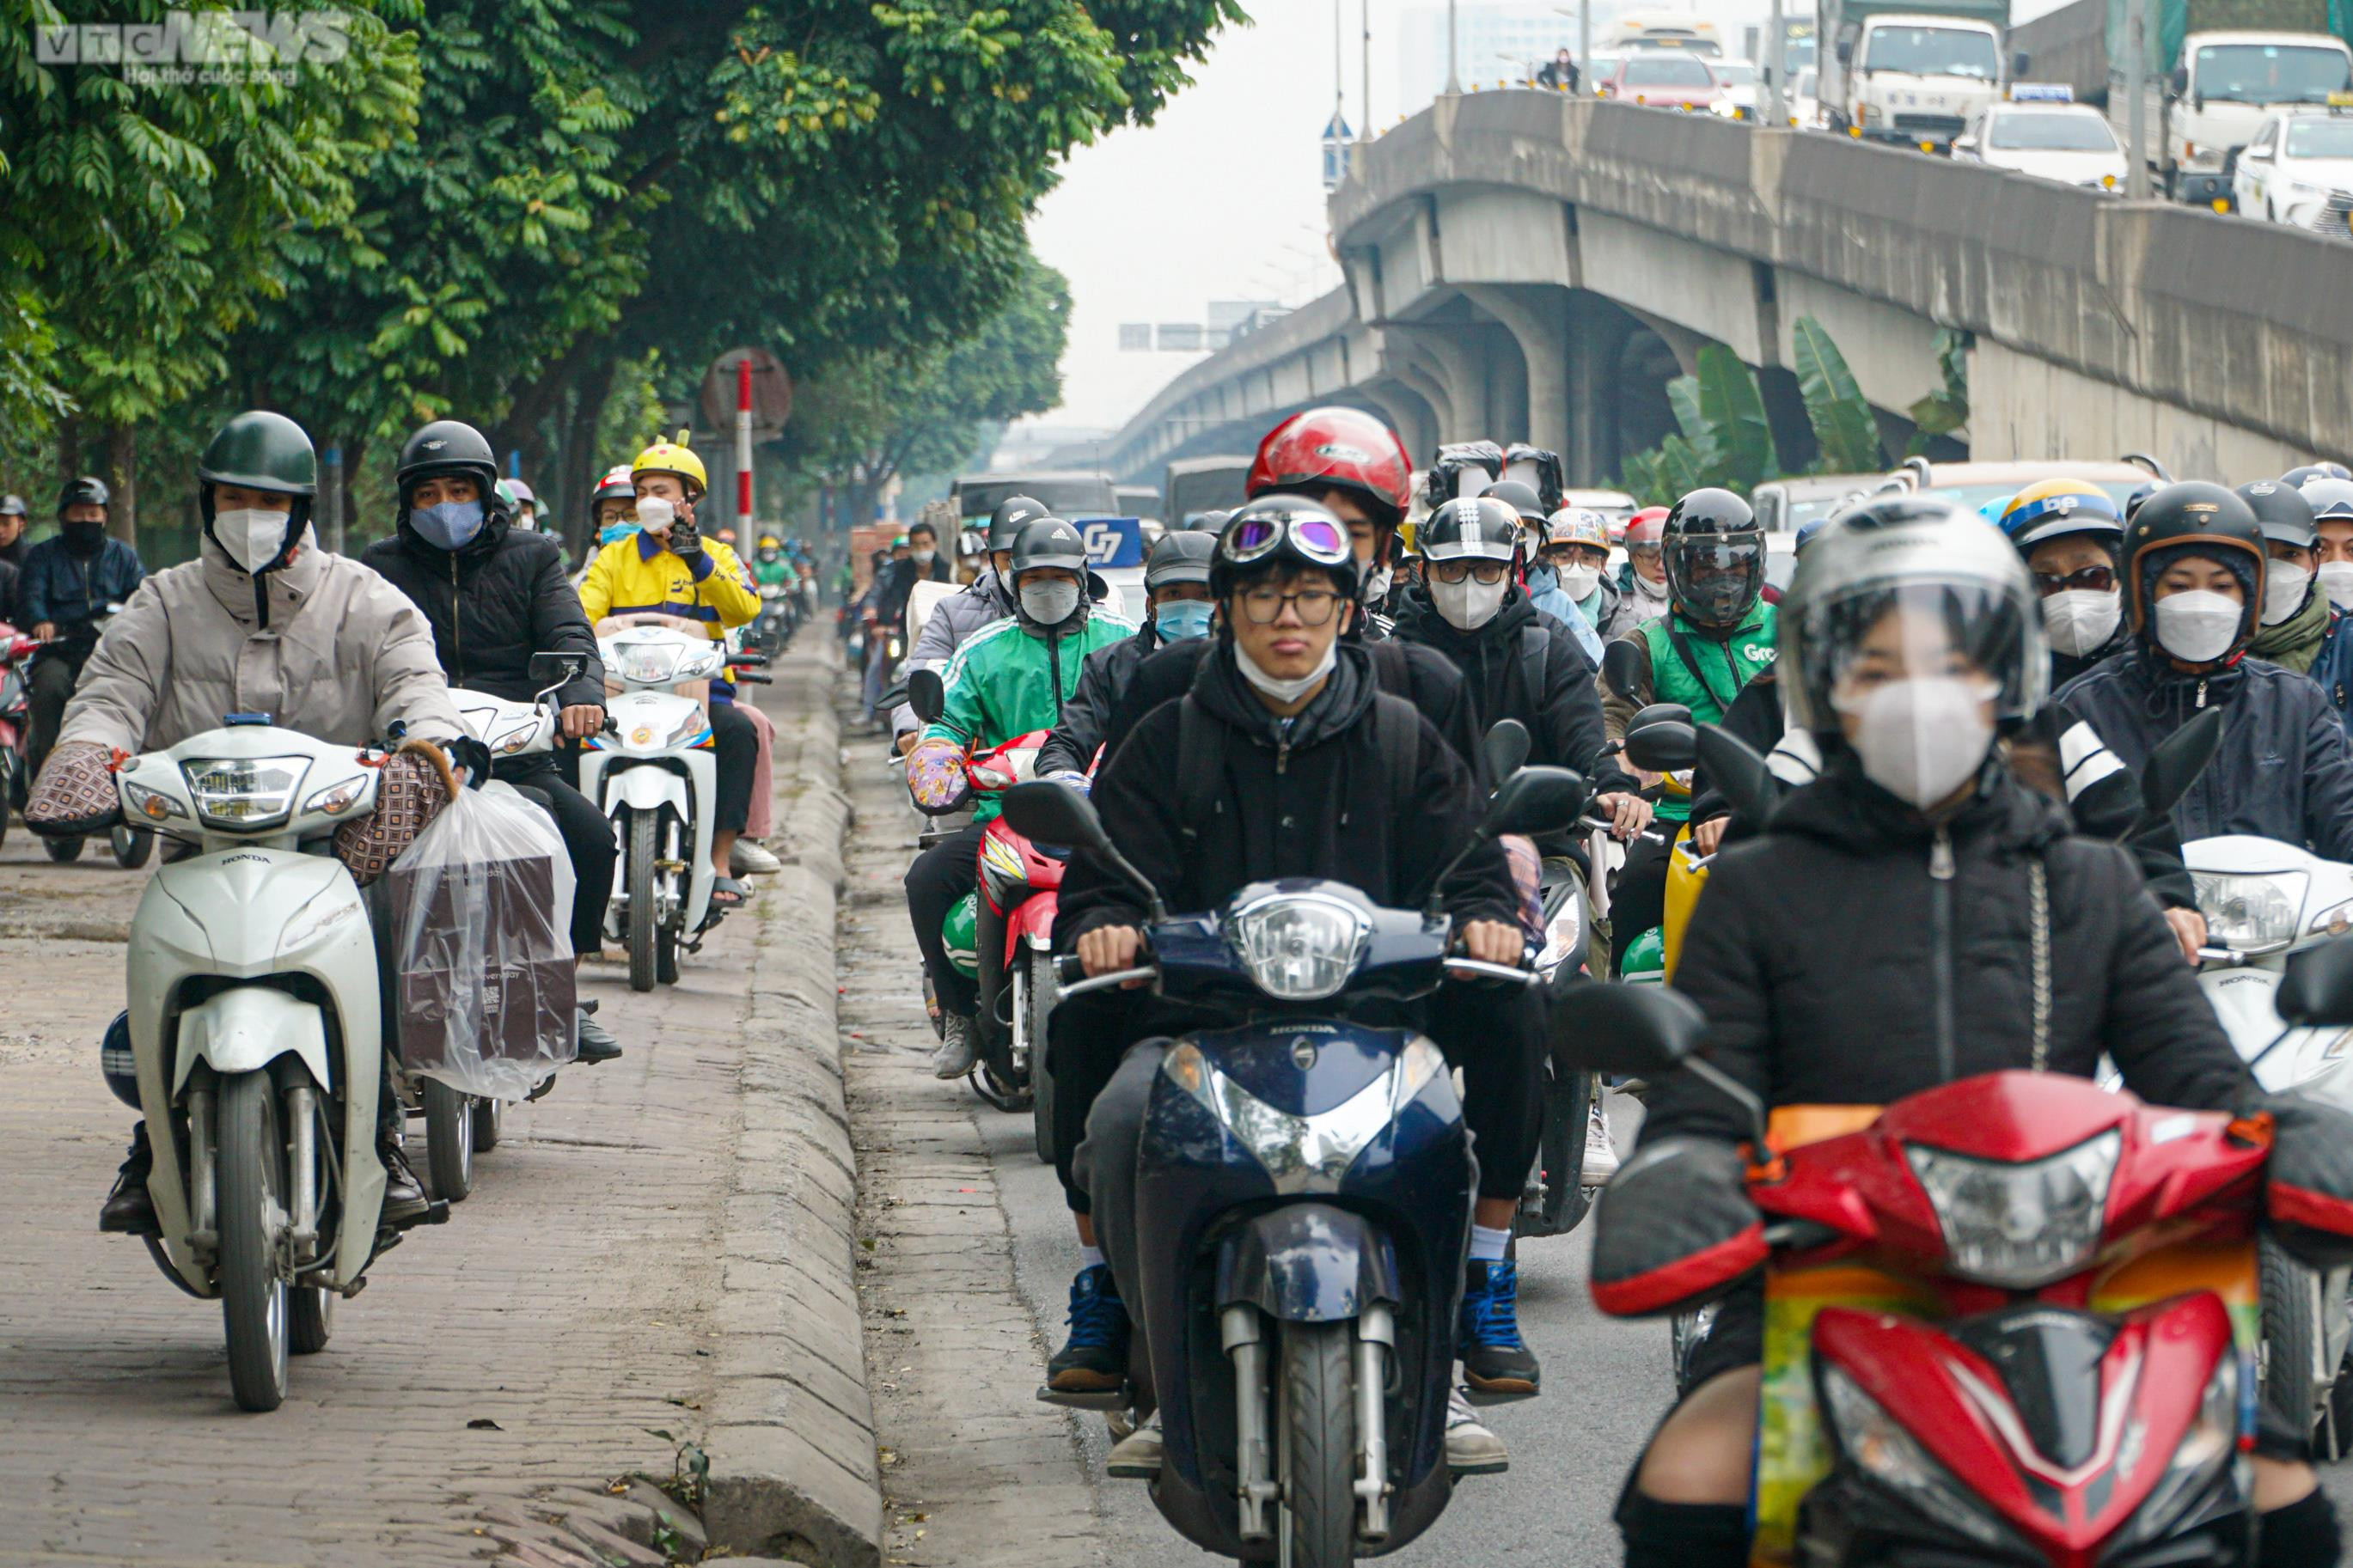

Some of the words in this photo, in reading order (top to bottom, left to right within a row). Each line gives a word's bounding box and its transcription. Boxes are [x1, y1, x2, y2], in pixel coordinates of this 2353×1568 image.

[2042, 496, 2078, 513] be
[1084, 523, 1122, 564] G7
[715, 568, 726, 581] be
[1744, 644, 1779, 662] Gra
[222, 854, 271, 865] HONDA
[2218, 975, 2270, 987] HONDA
[1270, 1024, 1338, 1034] HONDA
